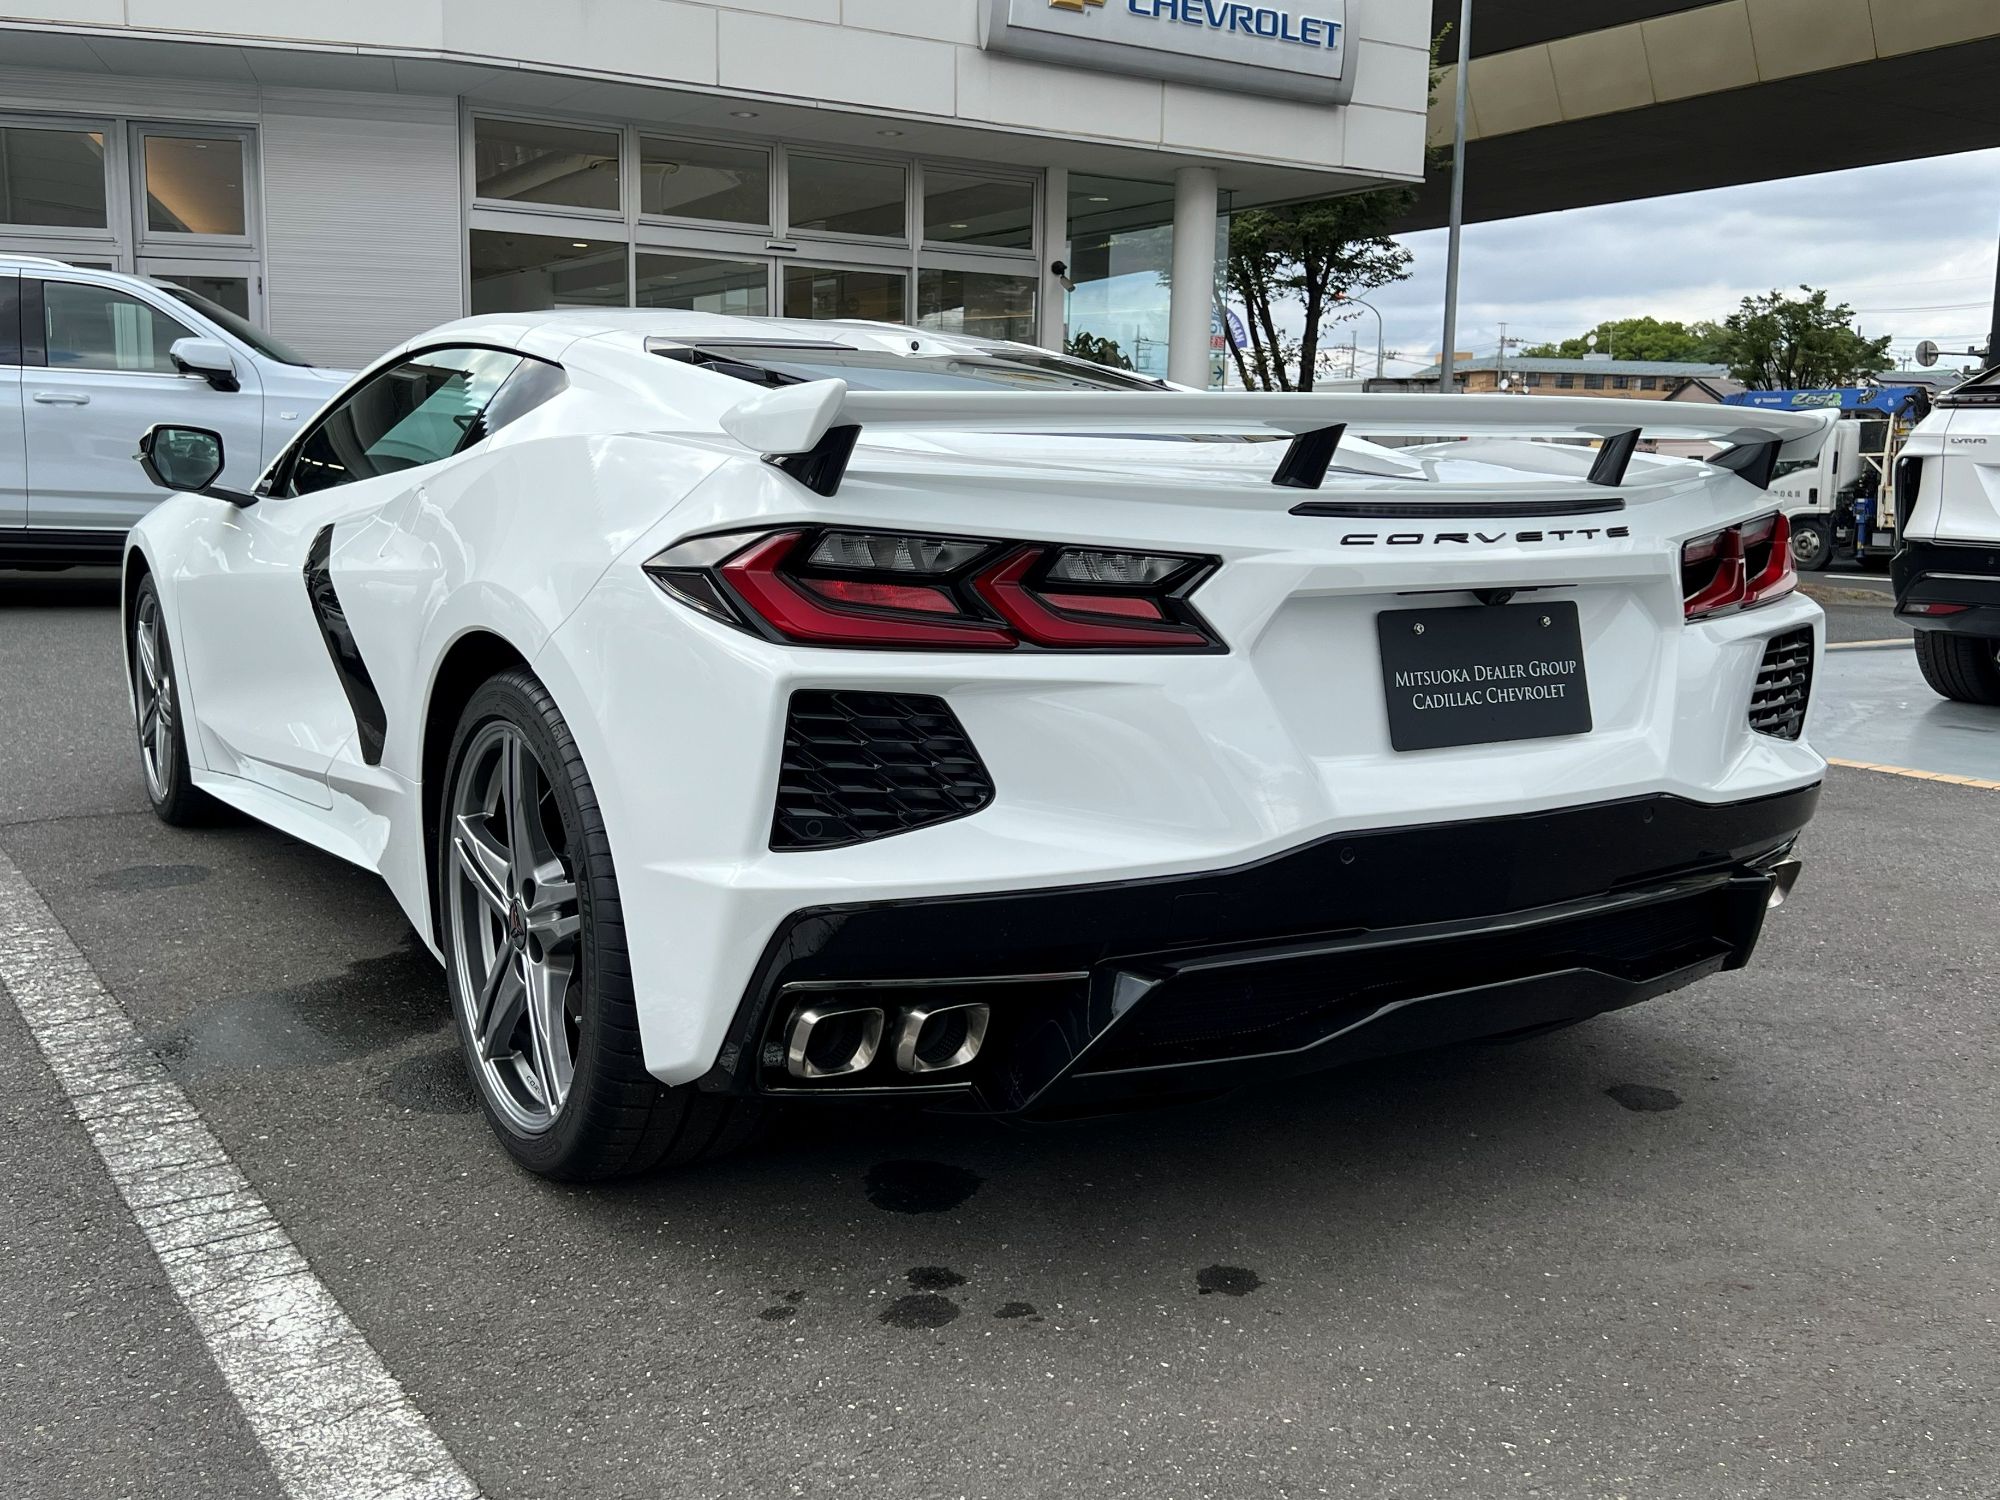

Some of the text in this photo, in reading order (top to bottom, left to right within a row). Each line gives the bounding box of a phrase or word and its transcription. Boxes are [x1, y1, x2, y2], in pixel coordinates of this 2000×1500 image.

[1128, 0, 1342, 49] CHEVROLET
[1340, 526, 1630, 546] CORVETTE
[1395, 660, 1577, 688] MITSUOKA DEALER GROUP
[1412, 684, 1566, 710] CADILLAC CHEVROLET
